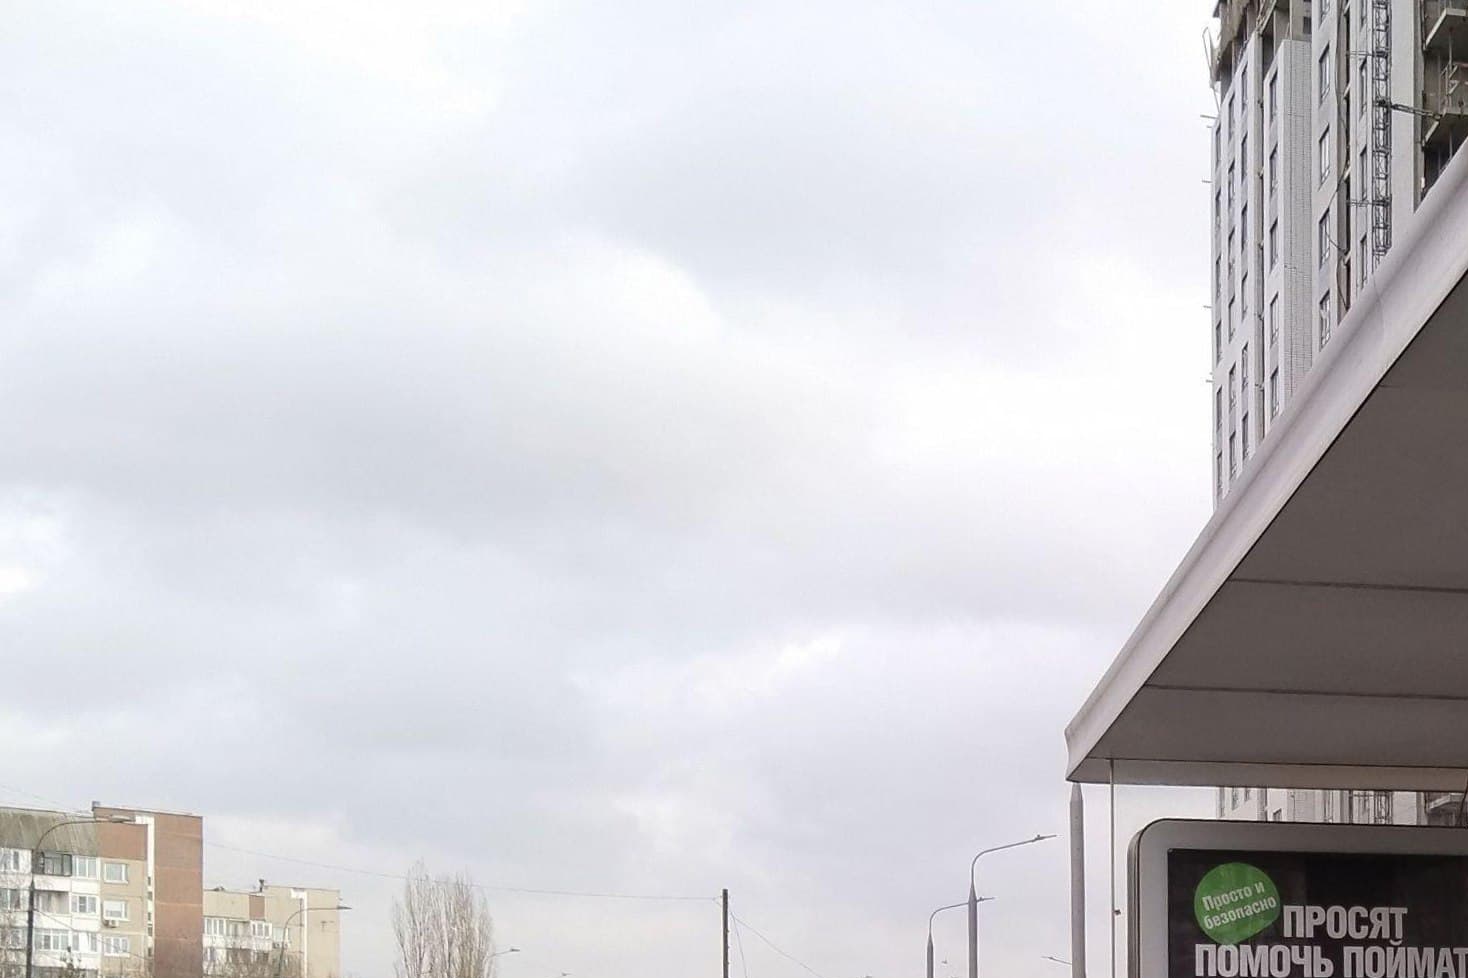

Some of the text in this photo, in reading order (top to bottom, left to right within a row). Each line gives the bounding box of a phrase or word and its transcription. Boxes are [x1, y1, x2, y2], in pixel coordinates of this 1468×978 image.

[1202, 881, 1265, 911] Просто и
[1203, 896, 1277, 930] безопасно
[1283, 905, 1408, 939] ПРОСЯТ
[1195, 943, 1334, 978] ПОМОЧЬ
